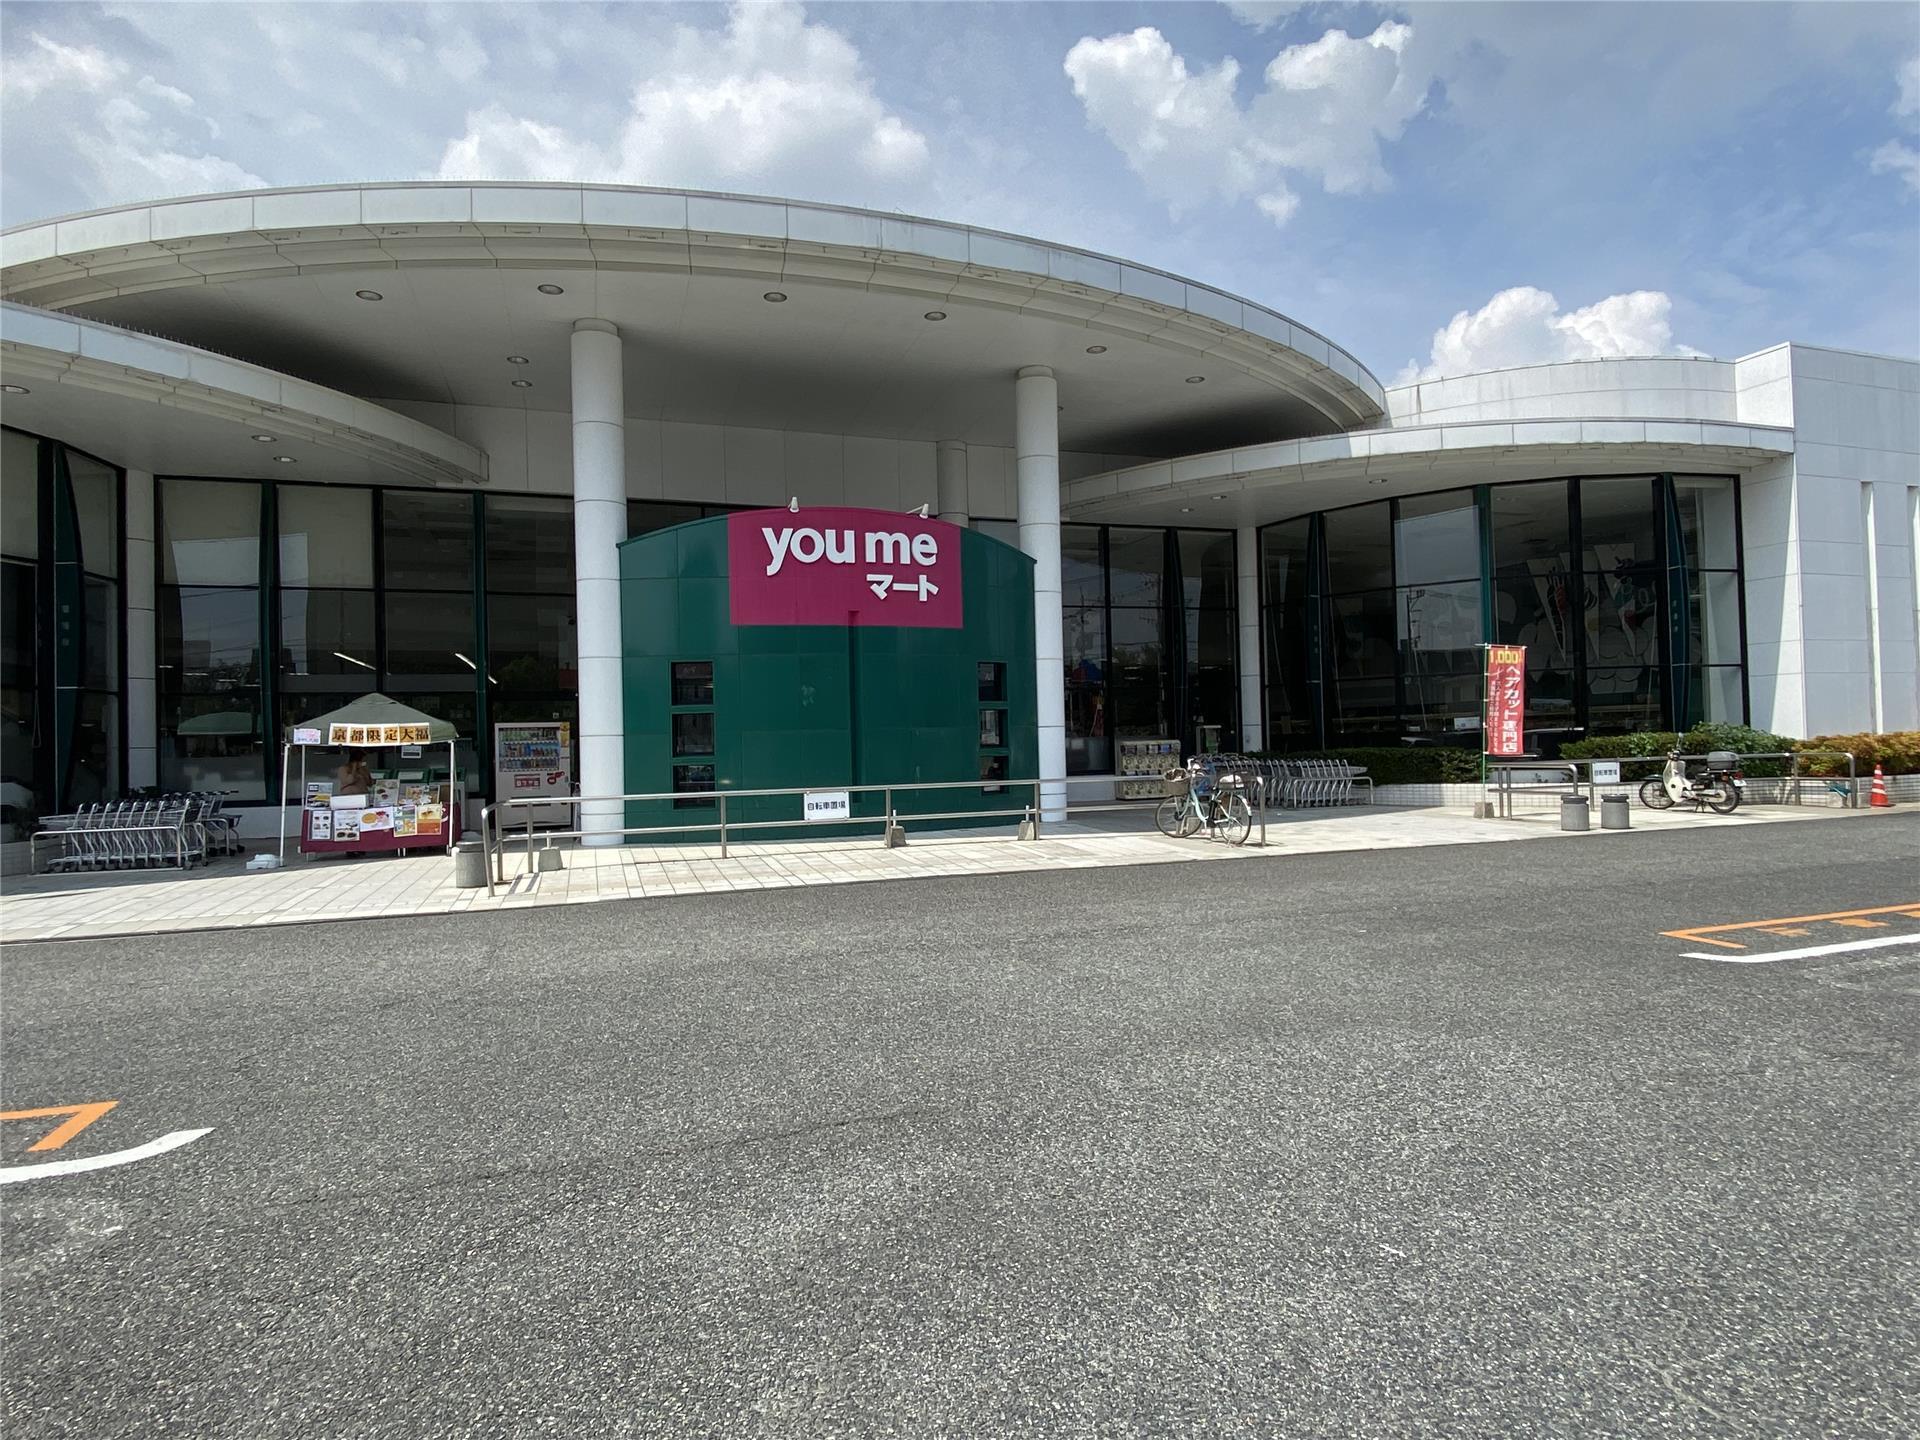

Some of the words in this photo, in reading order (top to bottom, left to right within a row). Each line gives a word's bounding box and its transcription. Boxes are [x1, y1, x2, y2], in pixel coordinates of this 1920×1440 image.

[761, 527, 856, 577] you
[865, 531, 938, 567] me
[866, 574, 940, 602] マート
[1489, 650, 1522, 665] 1,000
[1502, 665, 1521, 753] ヘアカット専門店
[332, 725, 430, 743] 京都限定大福
[808, 801, 846, 810] 自転車置場
